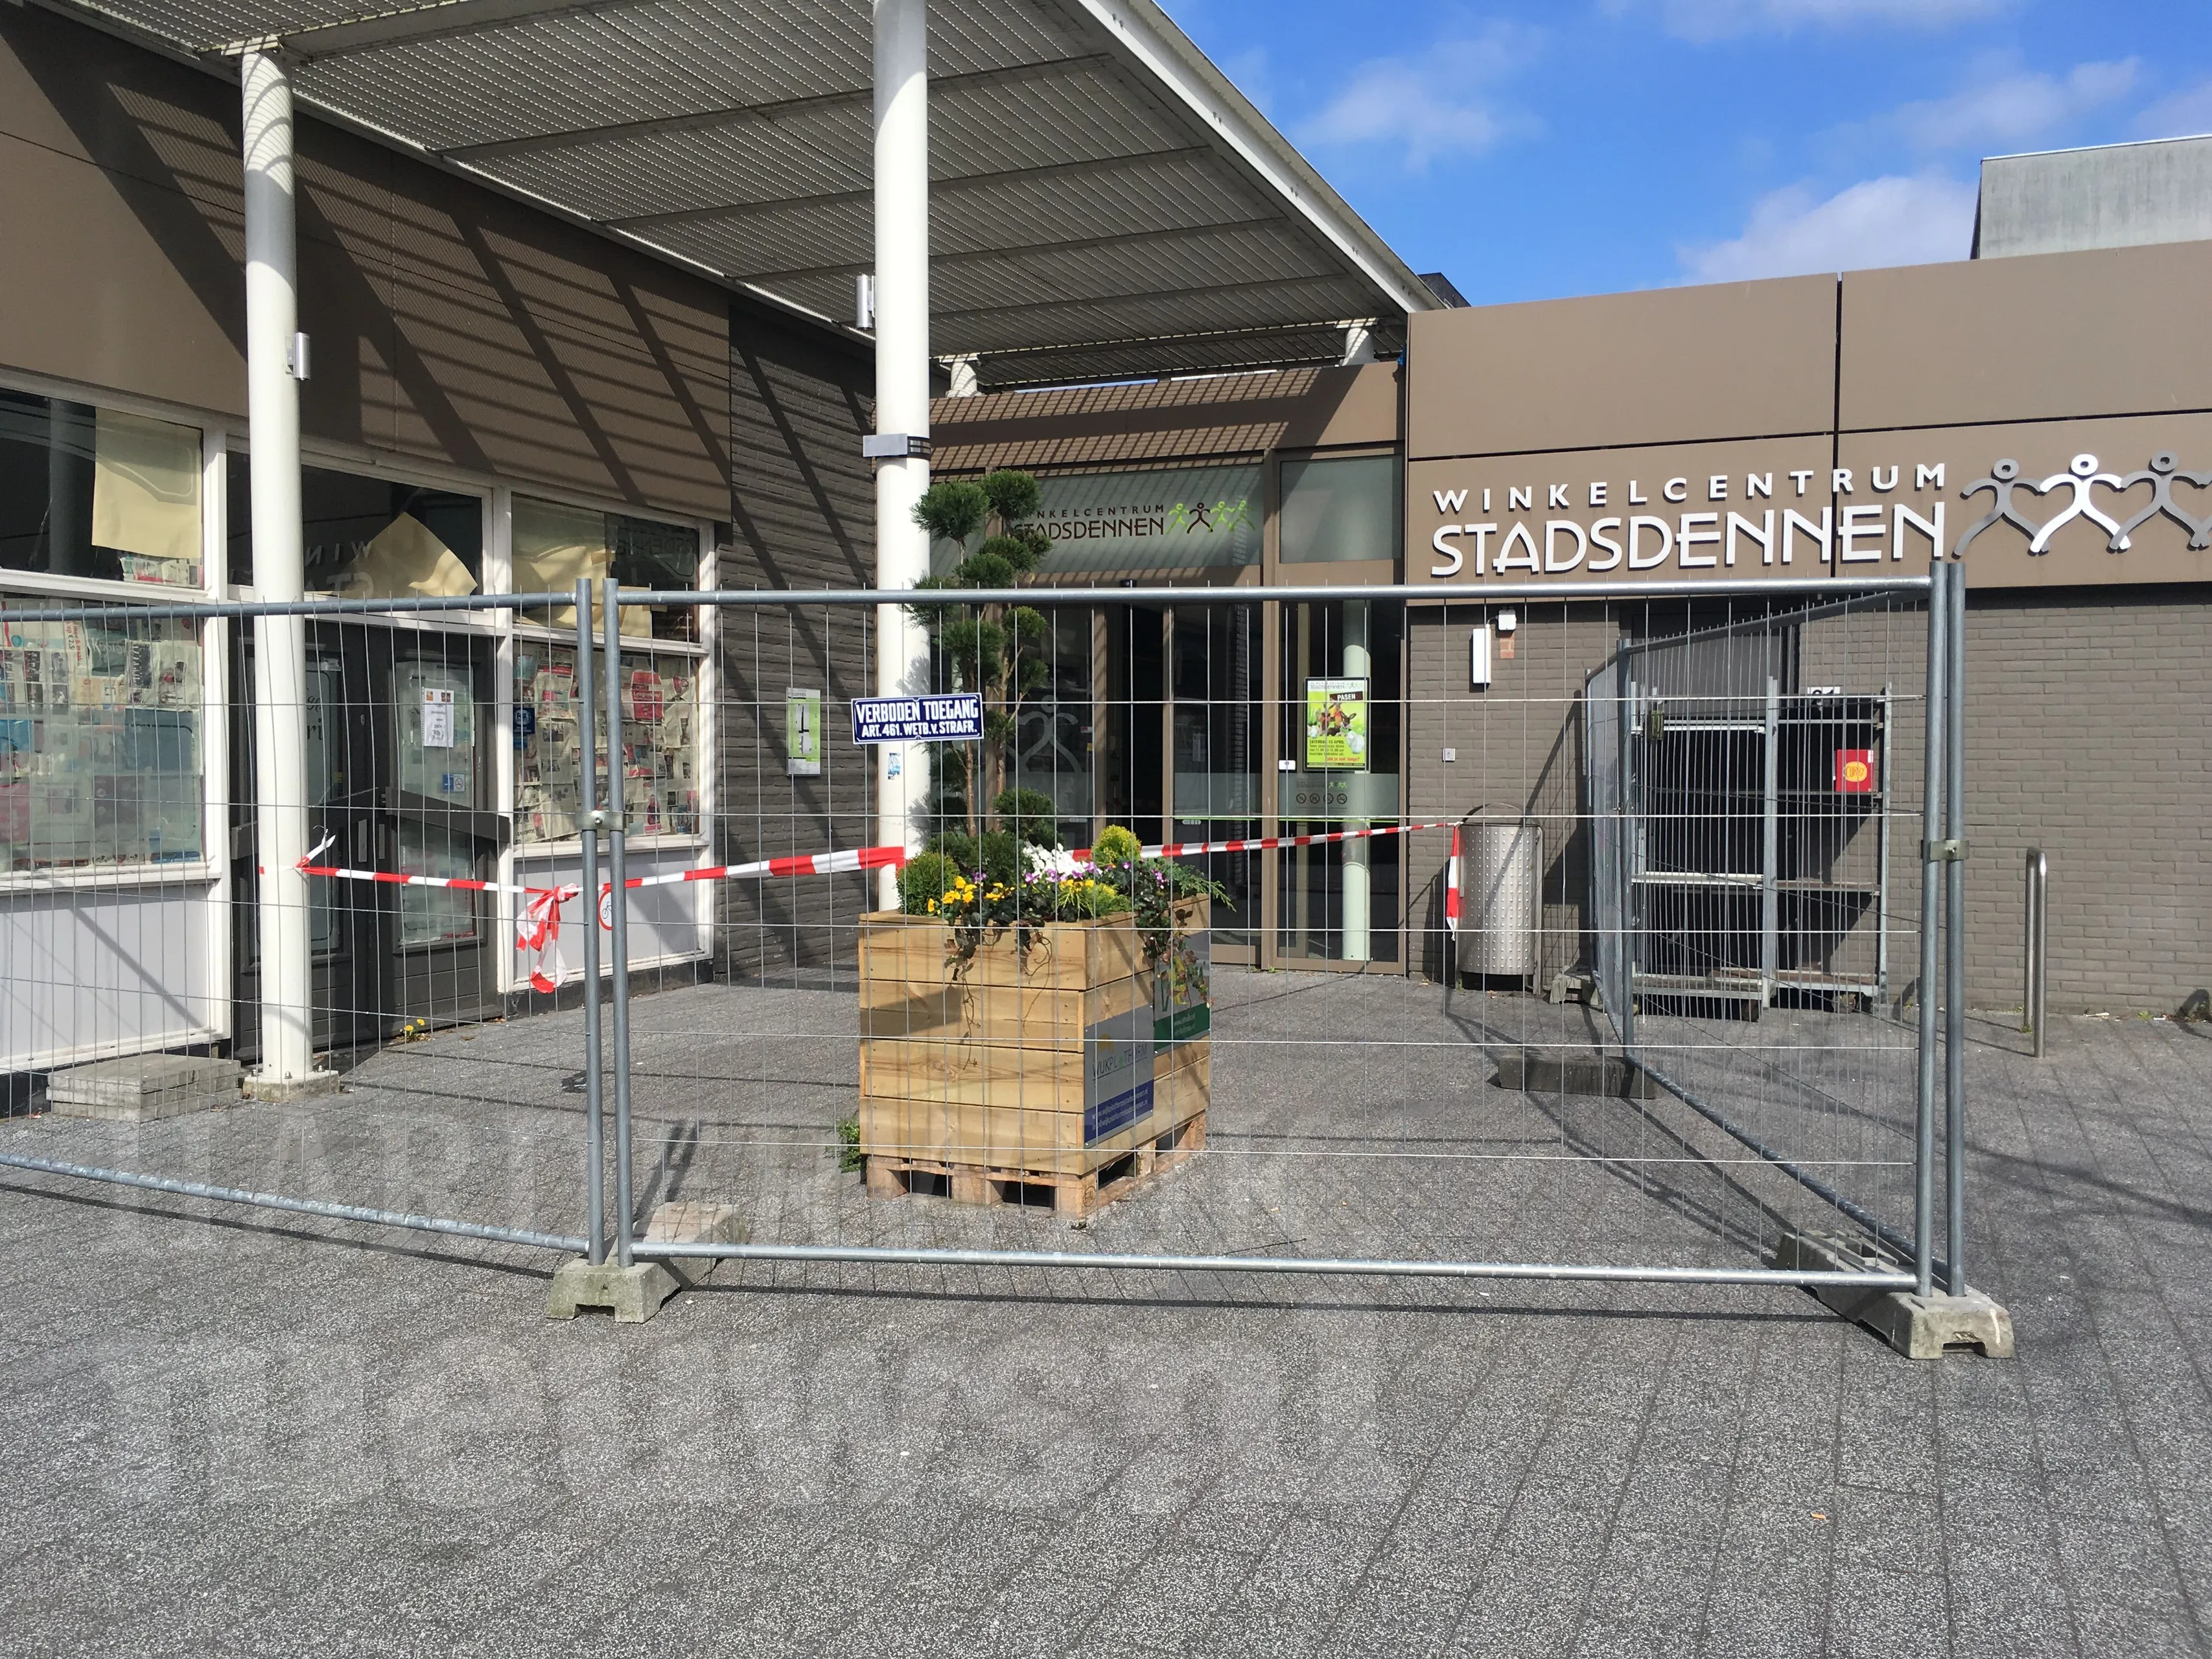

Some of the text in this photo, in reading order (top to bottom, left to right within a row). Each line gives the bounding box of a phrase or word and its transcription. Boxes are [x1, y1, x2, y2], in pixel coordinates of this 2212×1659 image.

[1433, 462, 1946, 513] WINKELCENTRUM
[1037, 504, 1164, 519] NKELCENTRUM
[1431, 501, 1946, 576] STADSDENNEN
[855, 699, 979, 723] VERBODEN TOEGANG
[861, 725, 881, 737] ART.
[903, 723, 931, 736] WETB.
[939, 720, 977, 734] STRAFR.
[1846, 766, 1865, 778] CURRY
